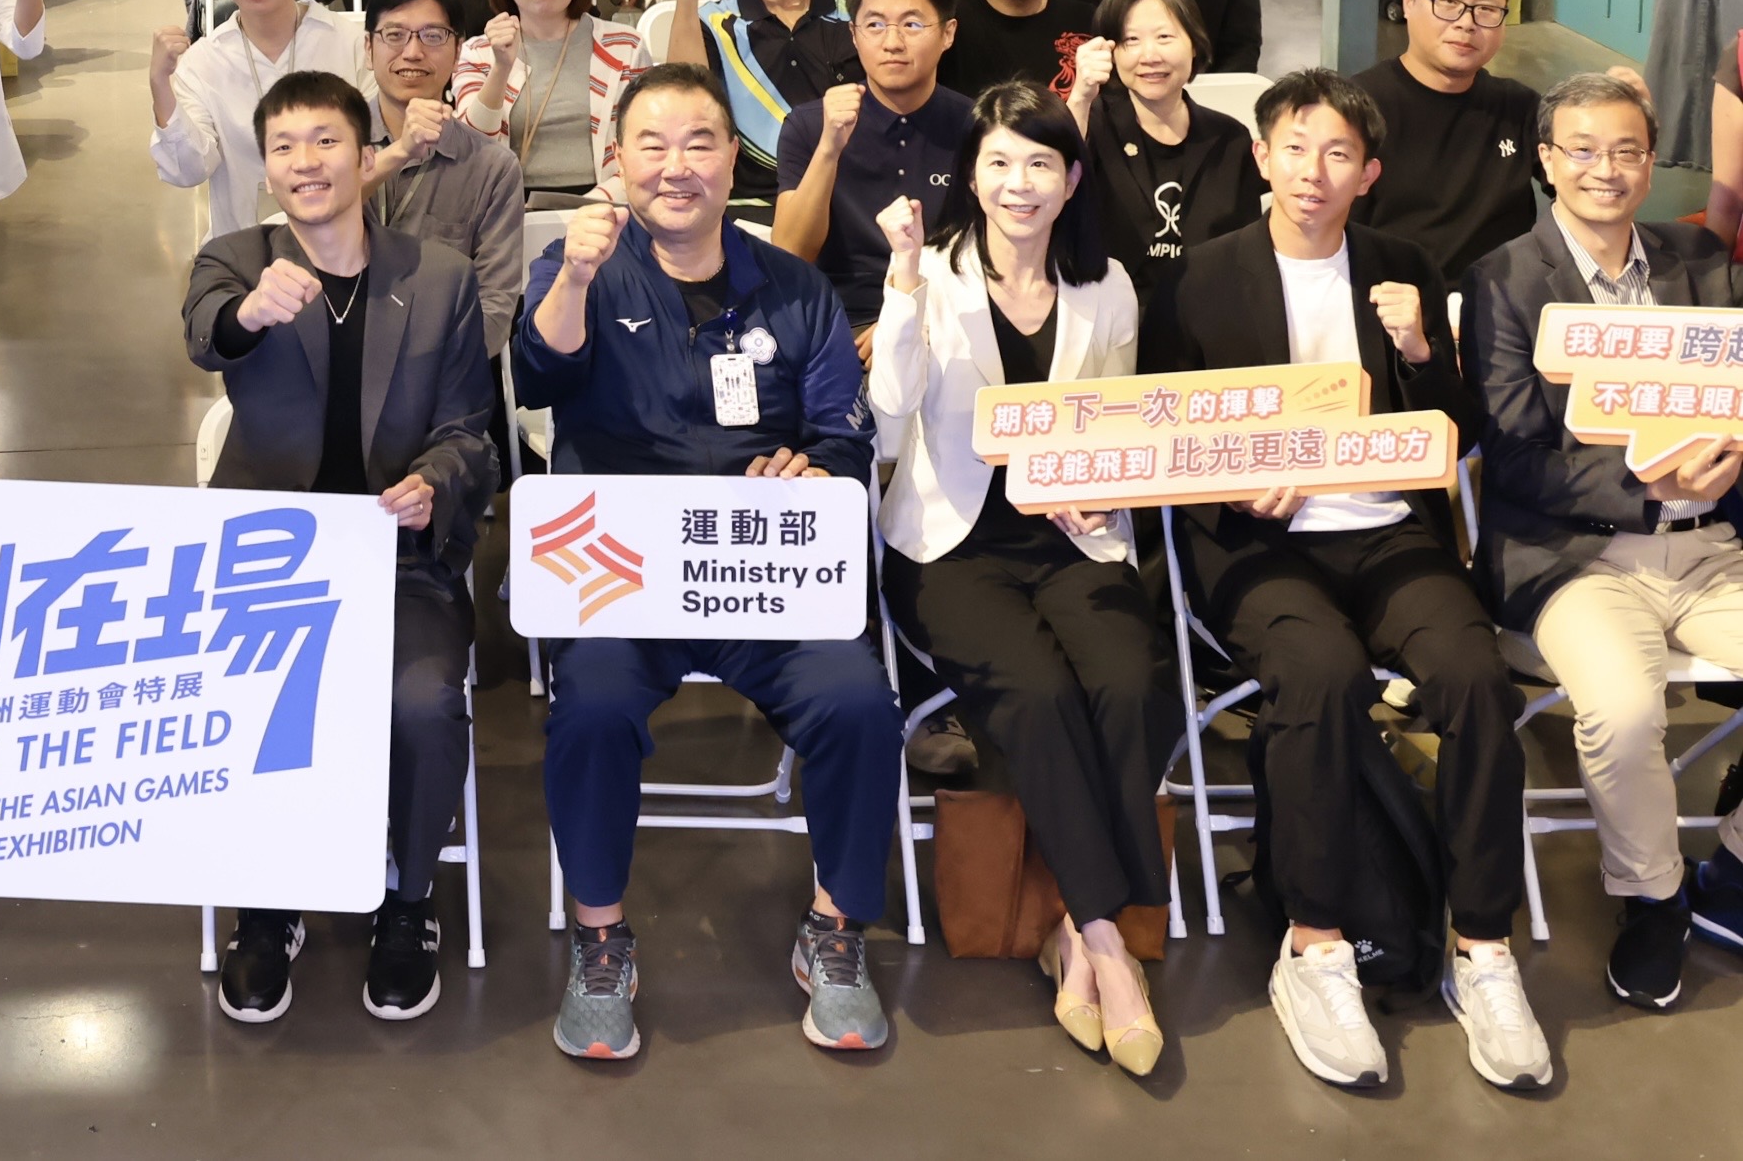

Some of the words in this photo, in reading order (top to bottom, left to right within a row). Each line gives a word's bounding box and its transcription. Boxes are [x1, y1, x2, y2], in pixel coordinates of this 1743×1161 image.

[1565, 323, 1673, 359] 我們要
[992, 402, 1055, 436] 期待
[1062, 387, 1180, 433] 下一次
[1187, 386, 1282, 421] 的揮擊
[1592, 382, 1743, 419] 不僅是眼
[1028, 447, 1154, 485] 球能飛到
[1166, 428, 1326, 478] 比光更遠
[1335, 428, 1432, 463] 的地方
[682, 508, 817, 546] 運動部
[683, 559, 808, 588] Ministry
[816, 560, 847, 584] of
[682, 590, 785, 618] Sports
[17, 726, 96, 772] THE
[115, 710, 232, 759] FIELD
[41, 781, 127, 816] ASIAN
[134, 767, 230, 803] GAMES
